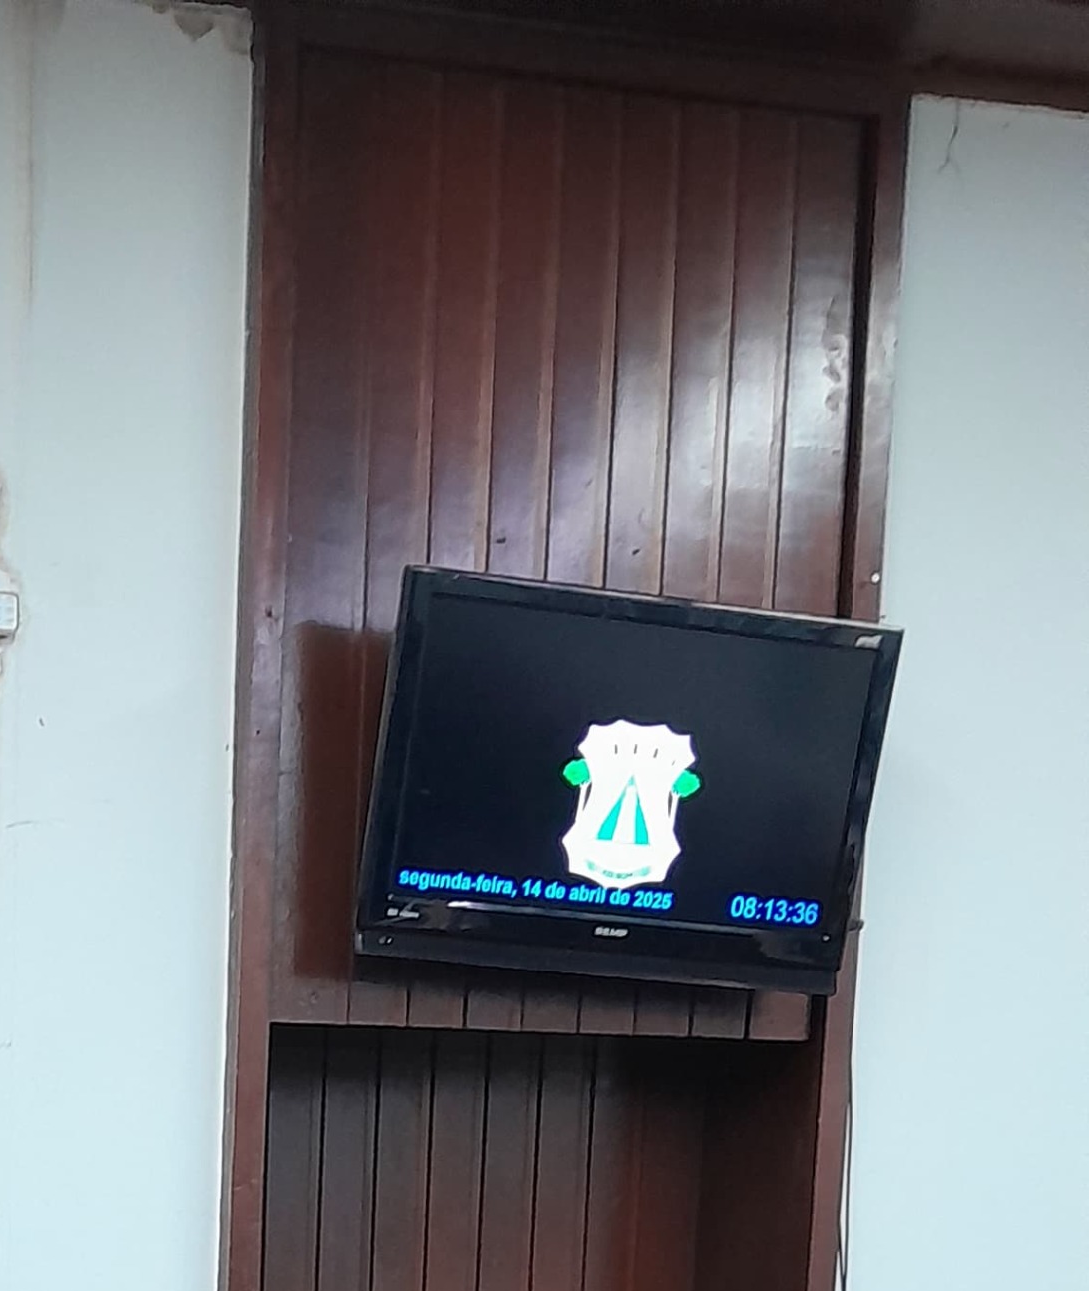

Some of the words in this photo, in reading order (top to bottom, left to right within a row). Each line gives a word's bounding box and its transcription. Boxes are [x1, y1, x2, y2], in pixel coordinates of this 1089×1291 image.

[399, 870, 517, 897] segunda-feira,
[522, 879, 542, 897] 14
[545, 881, 566, 899] de
[569, 885, 607, 904] abril
[609, 888, 630, 905] de
[633, 891, 673, 909] 2025
[731, 896, 818, 925] 08:13:36
